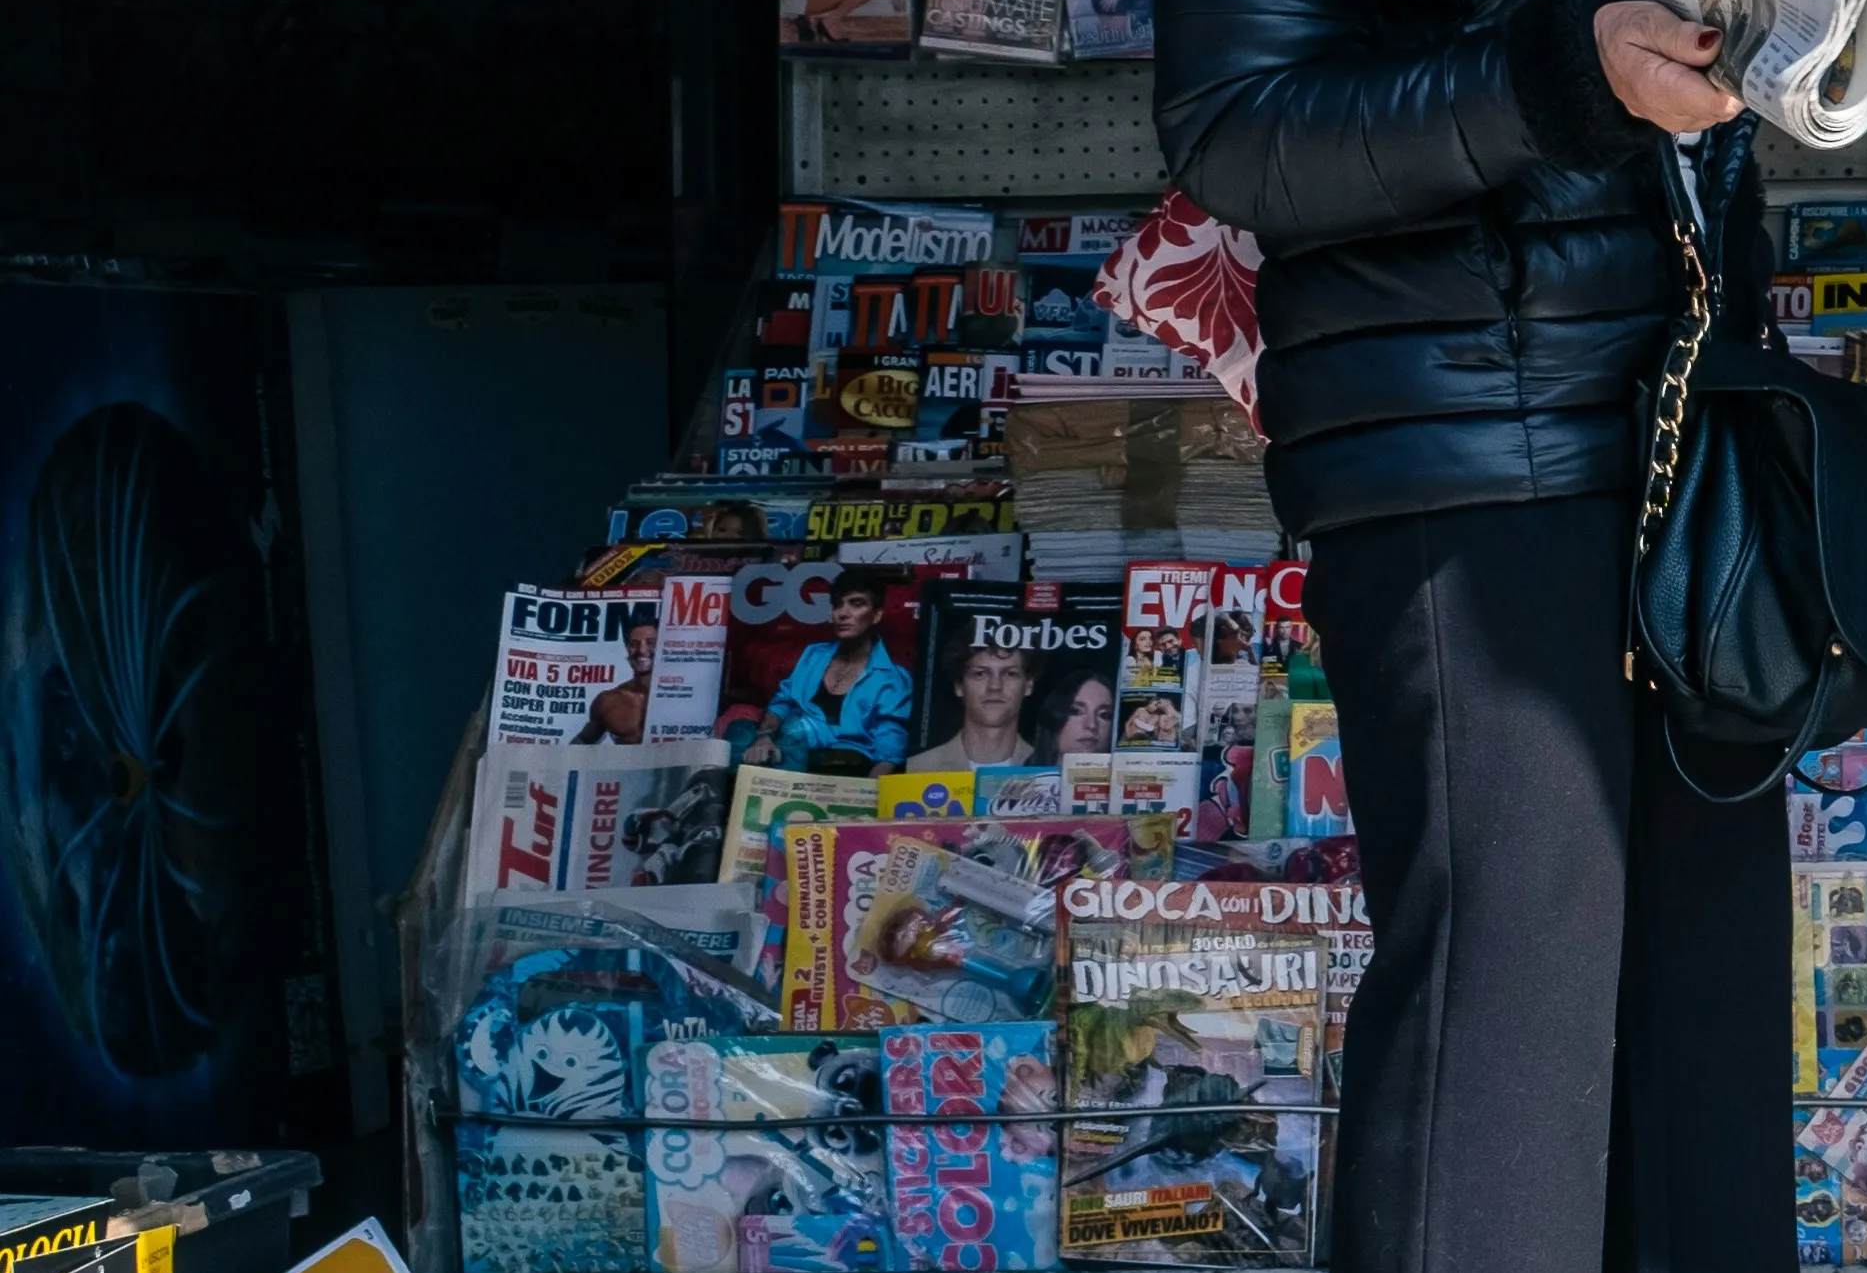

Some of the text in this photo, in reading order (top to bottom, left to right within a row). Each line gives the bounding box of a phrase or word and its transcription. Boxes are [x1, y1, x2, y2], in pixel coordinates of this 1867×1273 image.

[926, 9, 1027, 36] CASTINGS
[806, 504, 884, 541] SUPER
[971, 613, 1108, 652] Forbes
[508, 659, 615, 683] VIA 5 CHILI
[503, 680, 586, 699] CON QUESTA
[502, 697, 586, 715] SUPER DIETA
[1063, 879, 1222, 921] GIOCA
[1071, 953, 1317, 1001] DINOSAURI
[1068, 1214, 1221, 1243] DOVE VIVEVANO?
